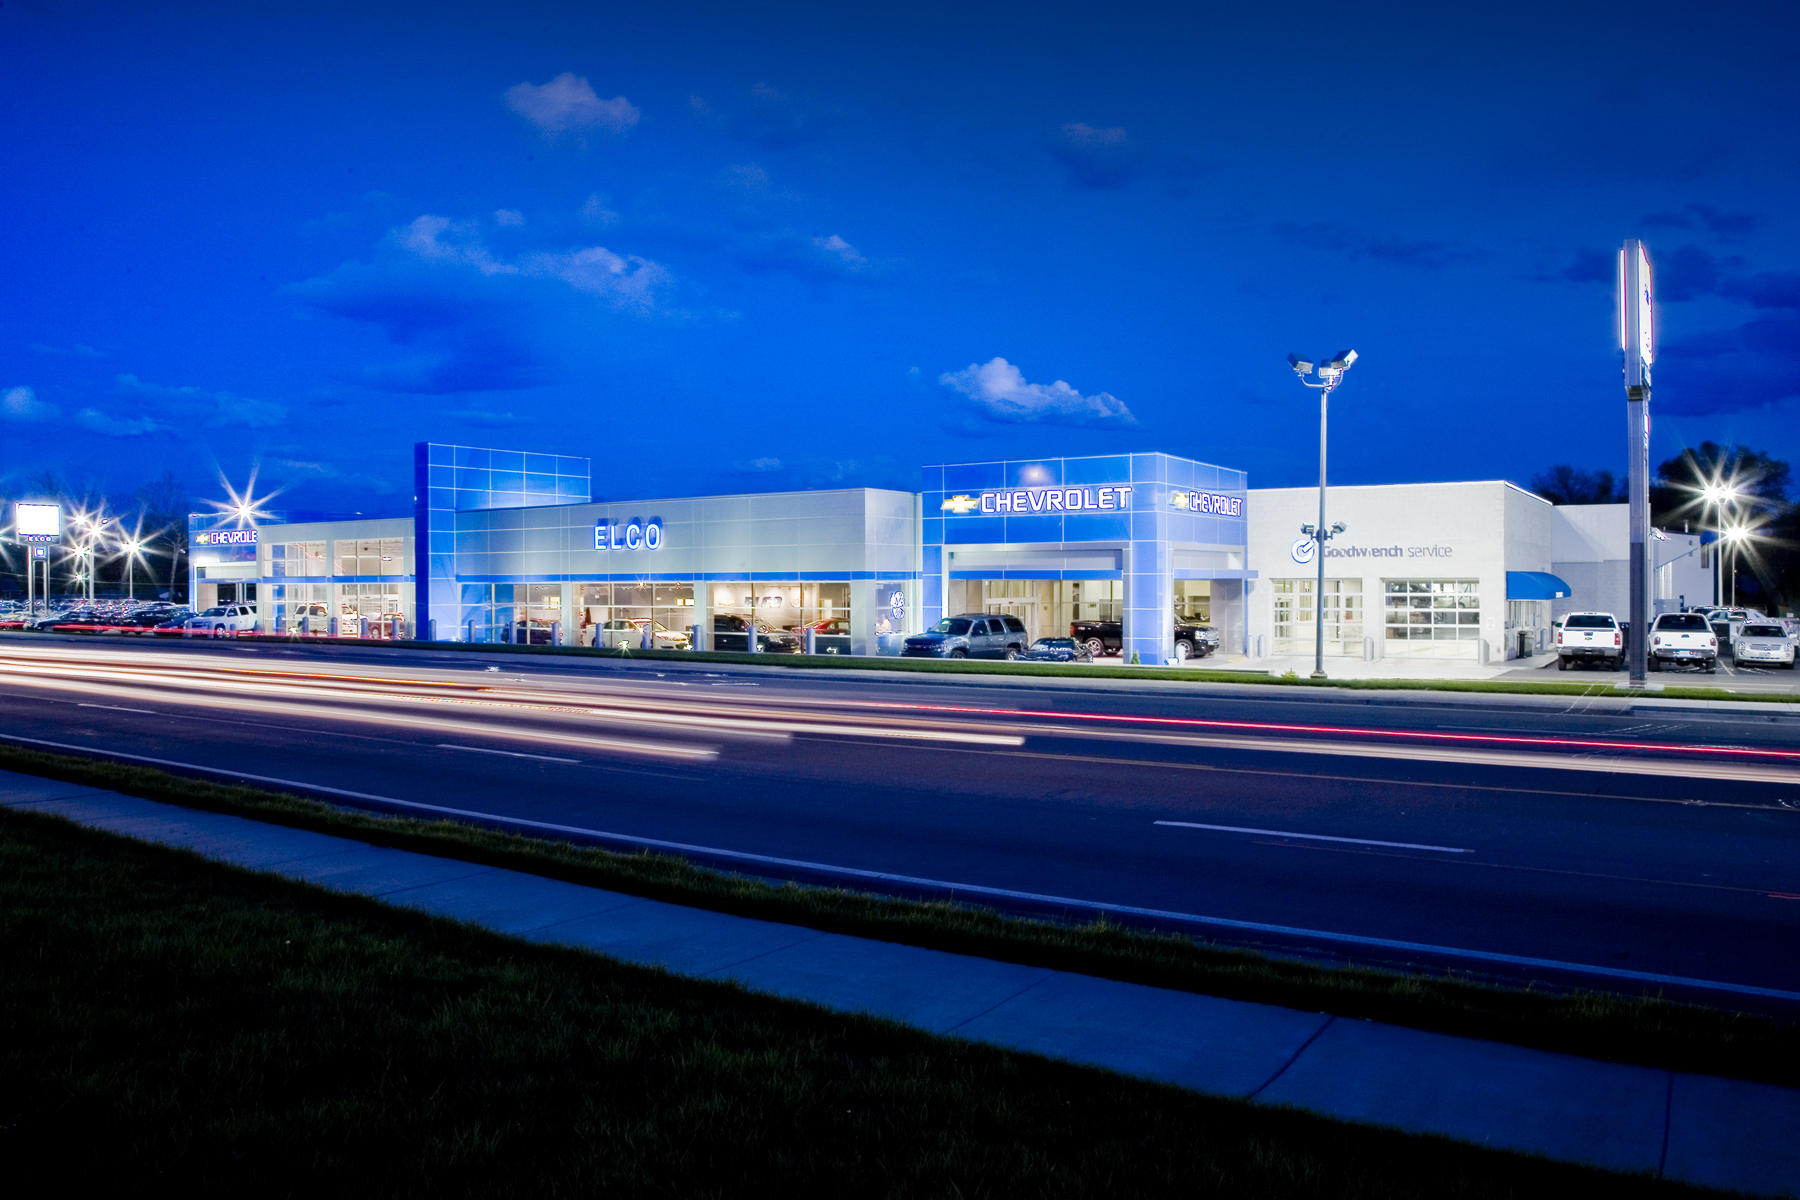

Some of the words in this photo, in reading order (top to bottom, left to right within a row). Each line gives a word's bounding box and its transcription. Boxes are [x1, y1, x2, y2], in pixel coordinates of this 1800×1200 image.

[981, 486, 1132, 513] CHEVROLET
[1189, 490, 1243, 517] CHEVROLET
[27, 535, 52, 543] ELCO
[594, 523, 661, 550] ELCO
[1323, 545, 1404, 558] Goodwench
[1408, 544, 1453, 558] service
